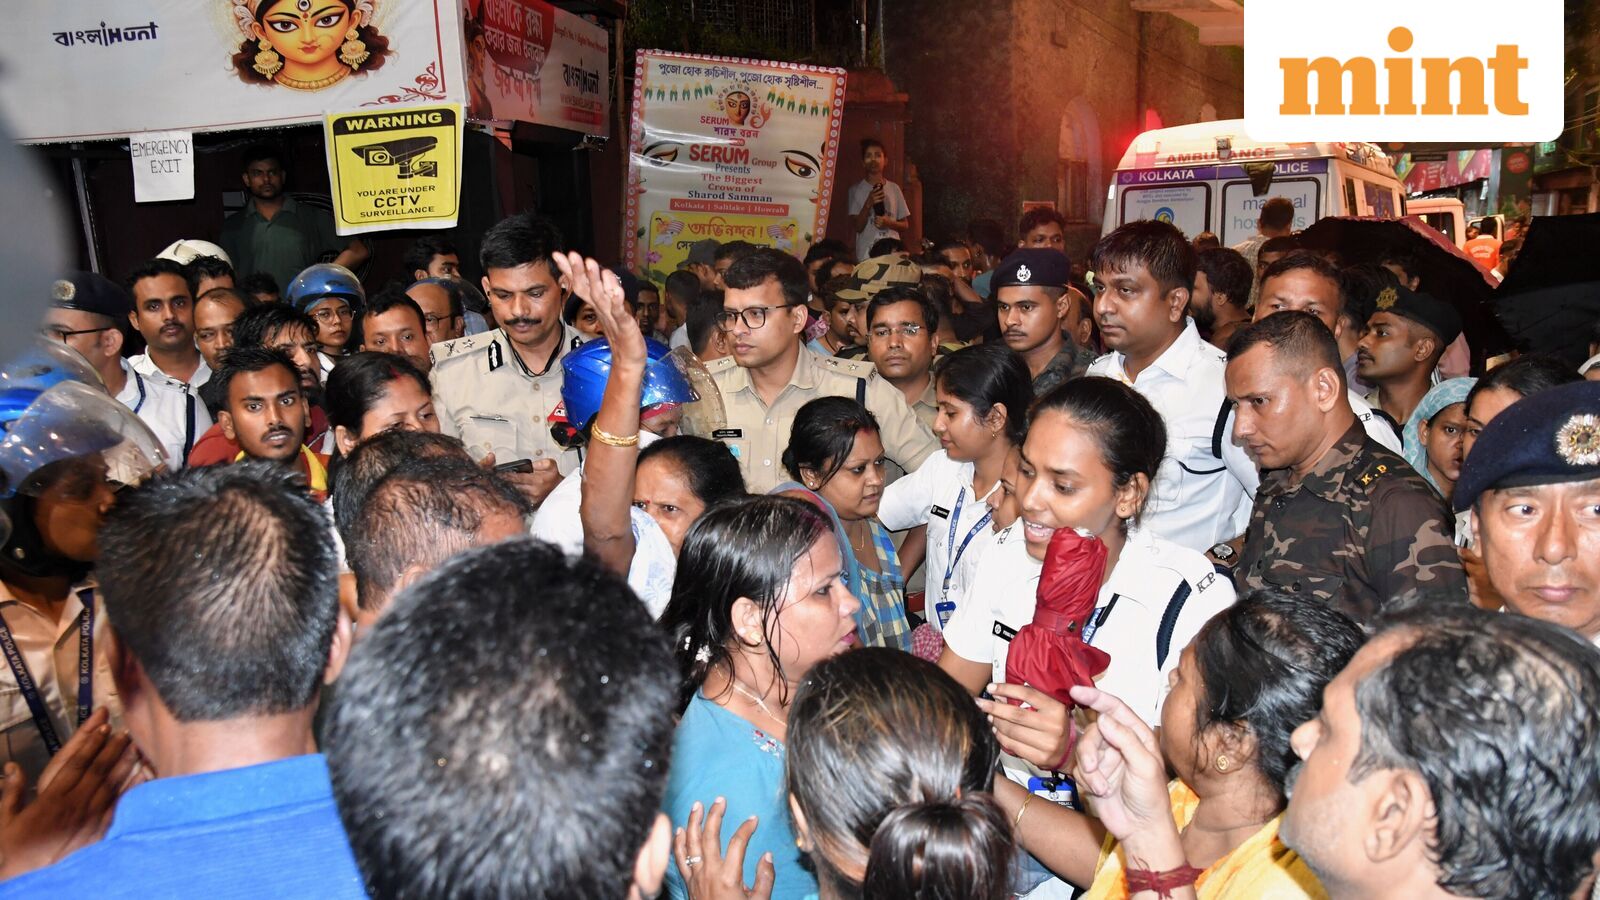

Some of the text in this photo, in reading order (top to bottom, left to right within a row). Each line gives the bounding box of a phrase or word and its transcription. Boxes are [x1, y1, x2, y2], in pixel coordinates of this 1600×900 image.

[659, 63, 681, 75] পুজো
[683, 65, 702, 76] হোক
[740, 72, 762, 85] পুজো
[763, 74, 783, 85] হোক
[345, 112, 443, 131] WARNING
[700, 116, 729, 126] SERUM
[132, 139, 189, 157] EMERGENCY
[1166, 147, 1275, 163] AMBUANCE
[689, 144, 777, 168] SERUM Group
[151, 159, 182, 173] EXIT
[715, 163, 751, 174] Presents
[1139, 162, 1309, 182] KOLKATA OLICE
[701, 173, 763, 185] The Biggest
[400, 185, 436, 193] UNDER
[708, 183, 741, 192] Crown
[374, 195, 421, 208] CCTV
[688, 190, 773, 202] Sharod Samman
[1243, 194, 1307, 210] maal
[360, 206, 435, 217] SURVEILLANCE
[81, 636, 91, 674] KOLKATA
